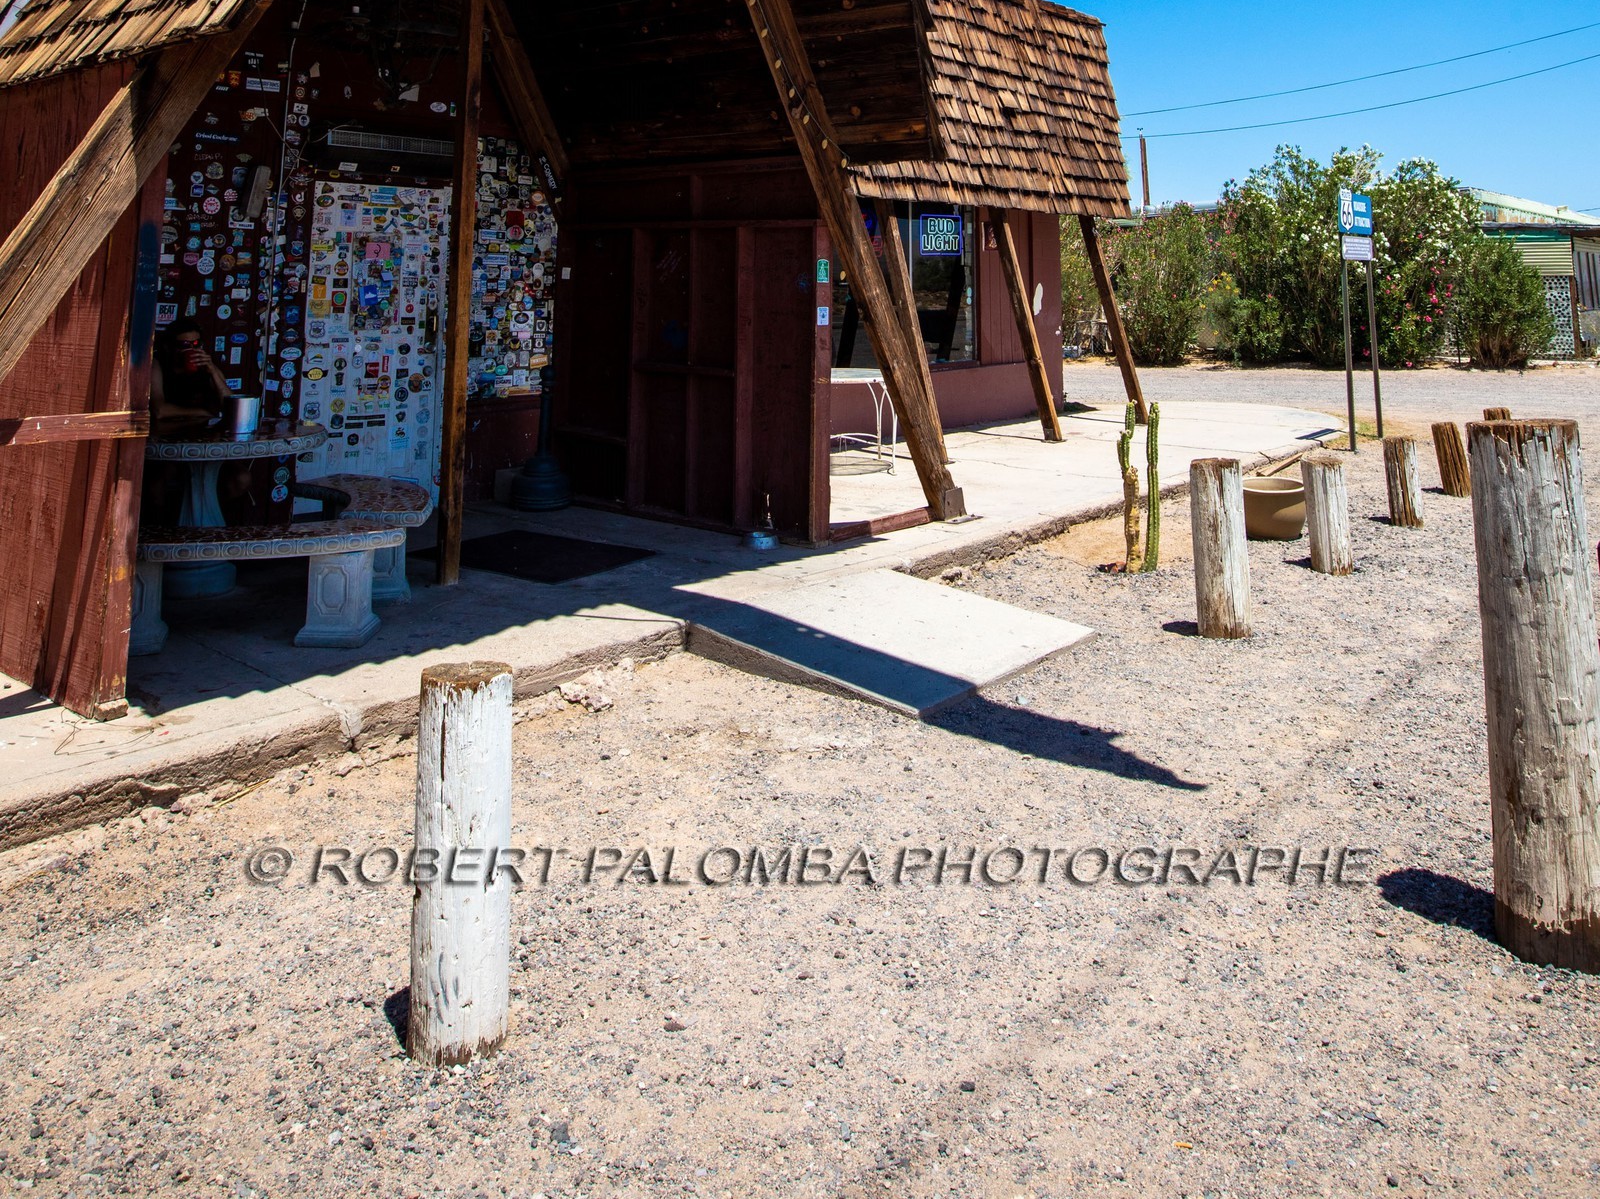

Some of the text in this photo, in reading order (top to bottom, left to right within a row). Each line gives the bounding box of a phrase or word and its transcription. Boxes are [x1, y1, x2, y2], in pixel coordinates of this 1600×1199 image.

[543, 163, 557, 190] COMEDY
[1342, 202, 1353, 226] 66
[928, 217, 955, 234] BUD
[922, 234, 960, 251] LIGHT
[159, 304, 177, 314] BEAT
